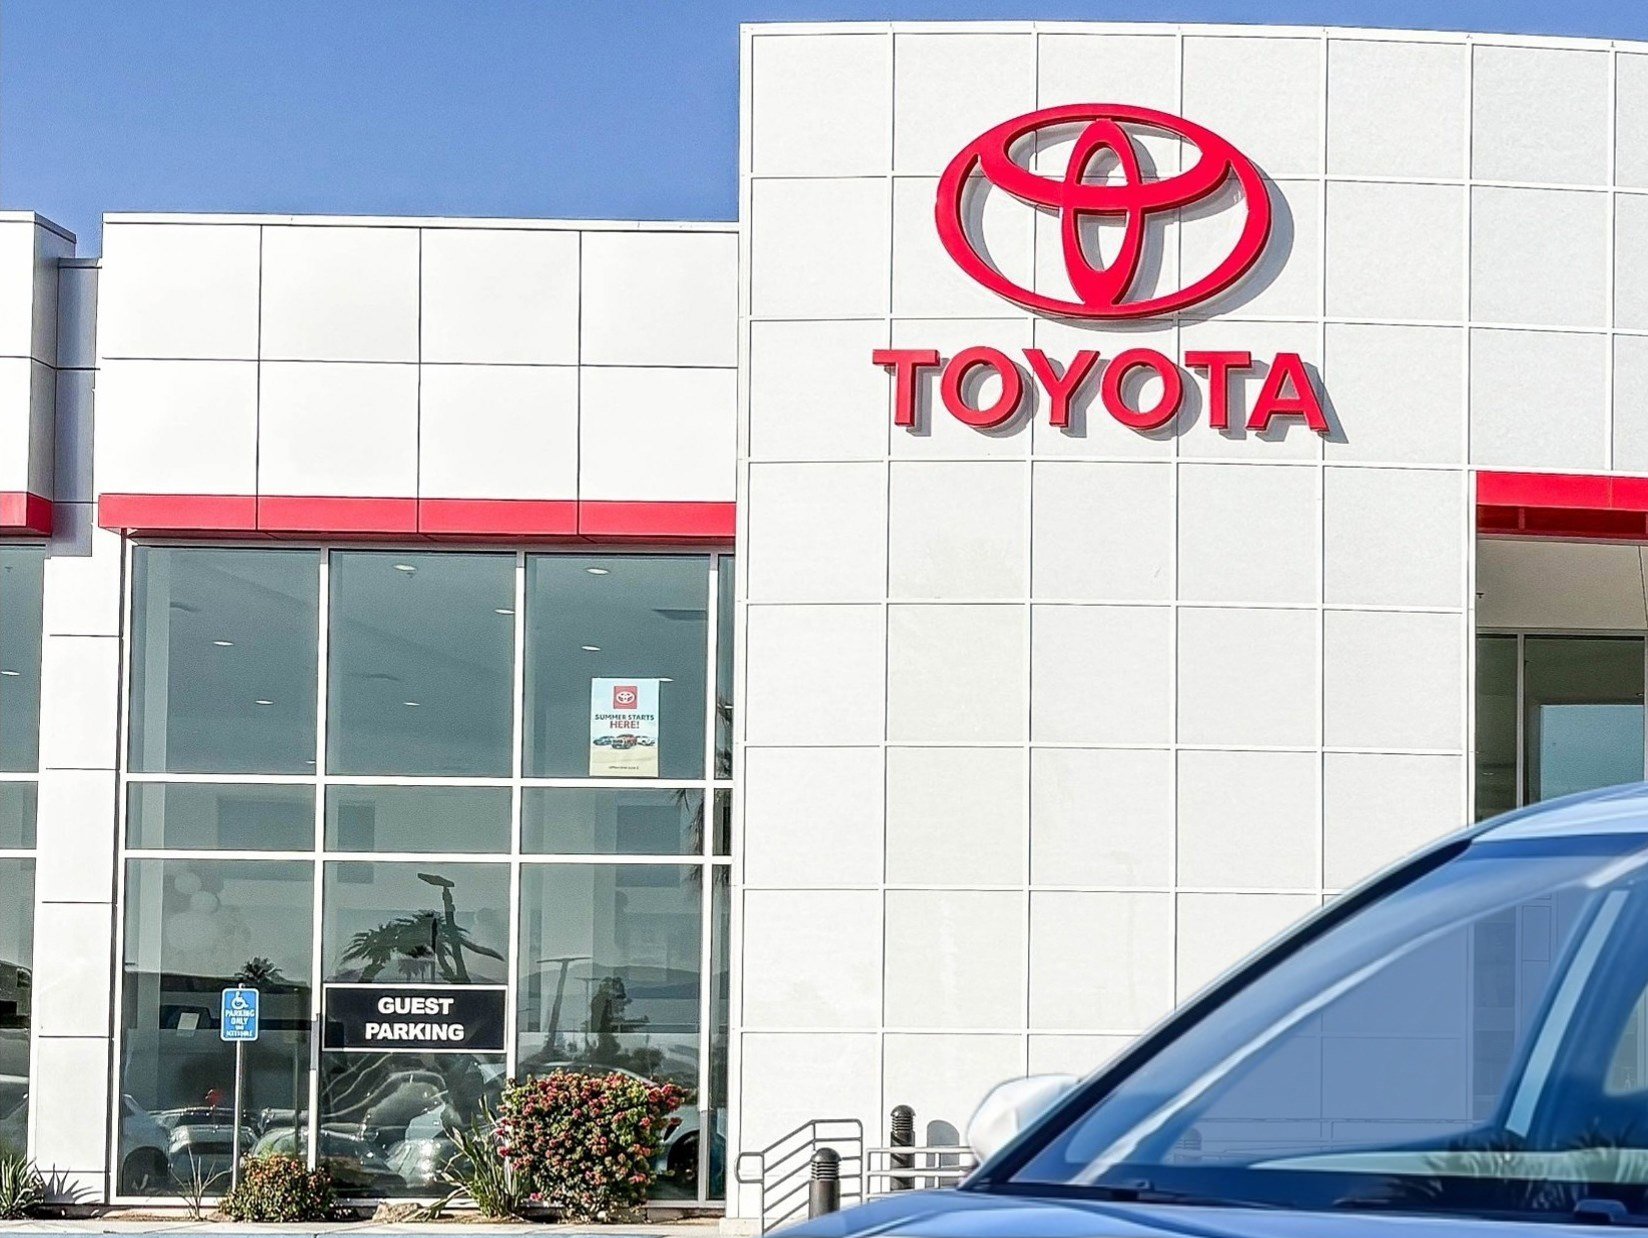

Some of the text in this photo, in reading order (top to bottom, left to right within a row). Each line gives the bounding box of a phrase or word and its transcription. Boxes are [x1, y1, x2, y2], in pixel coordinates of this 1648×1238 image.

[872, 346, 1330, 432] TOYOTA
[610, 721, 640, 729] HERE!
[377, 997, 454, 1015] GUEST
[365, 1022, 465, 1041] PARKING
